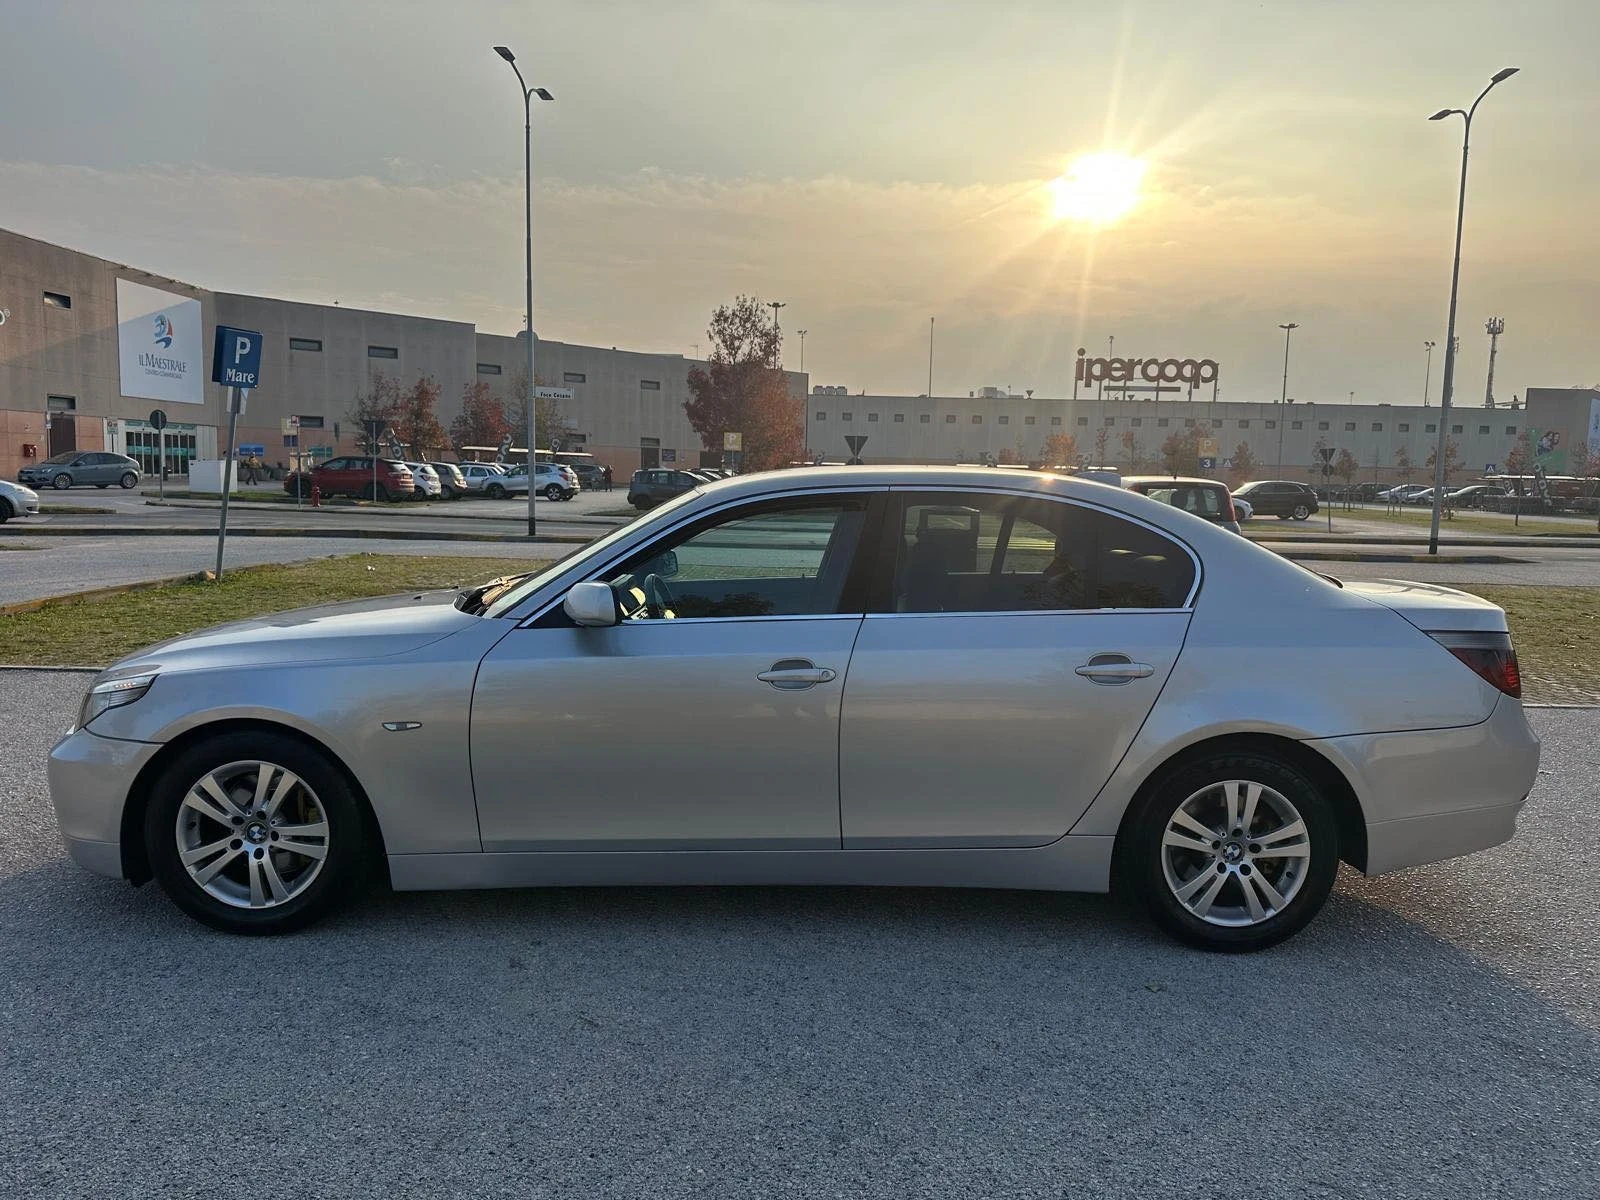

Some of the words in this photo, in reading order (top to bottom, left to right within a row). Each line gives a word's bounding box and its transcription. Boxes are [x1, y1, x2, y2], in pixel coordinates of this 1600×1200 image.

[235, 336, 251, 364] P
[225, 367, 255, 384] Mare
[1075, 348, 1219, 390] ipercoop
[1203, 458, 1211, 468] 3
